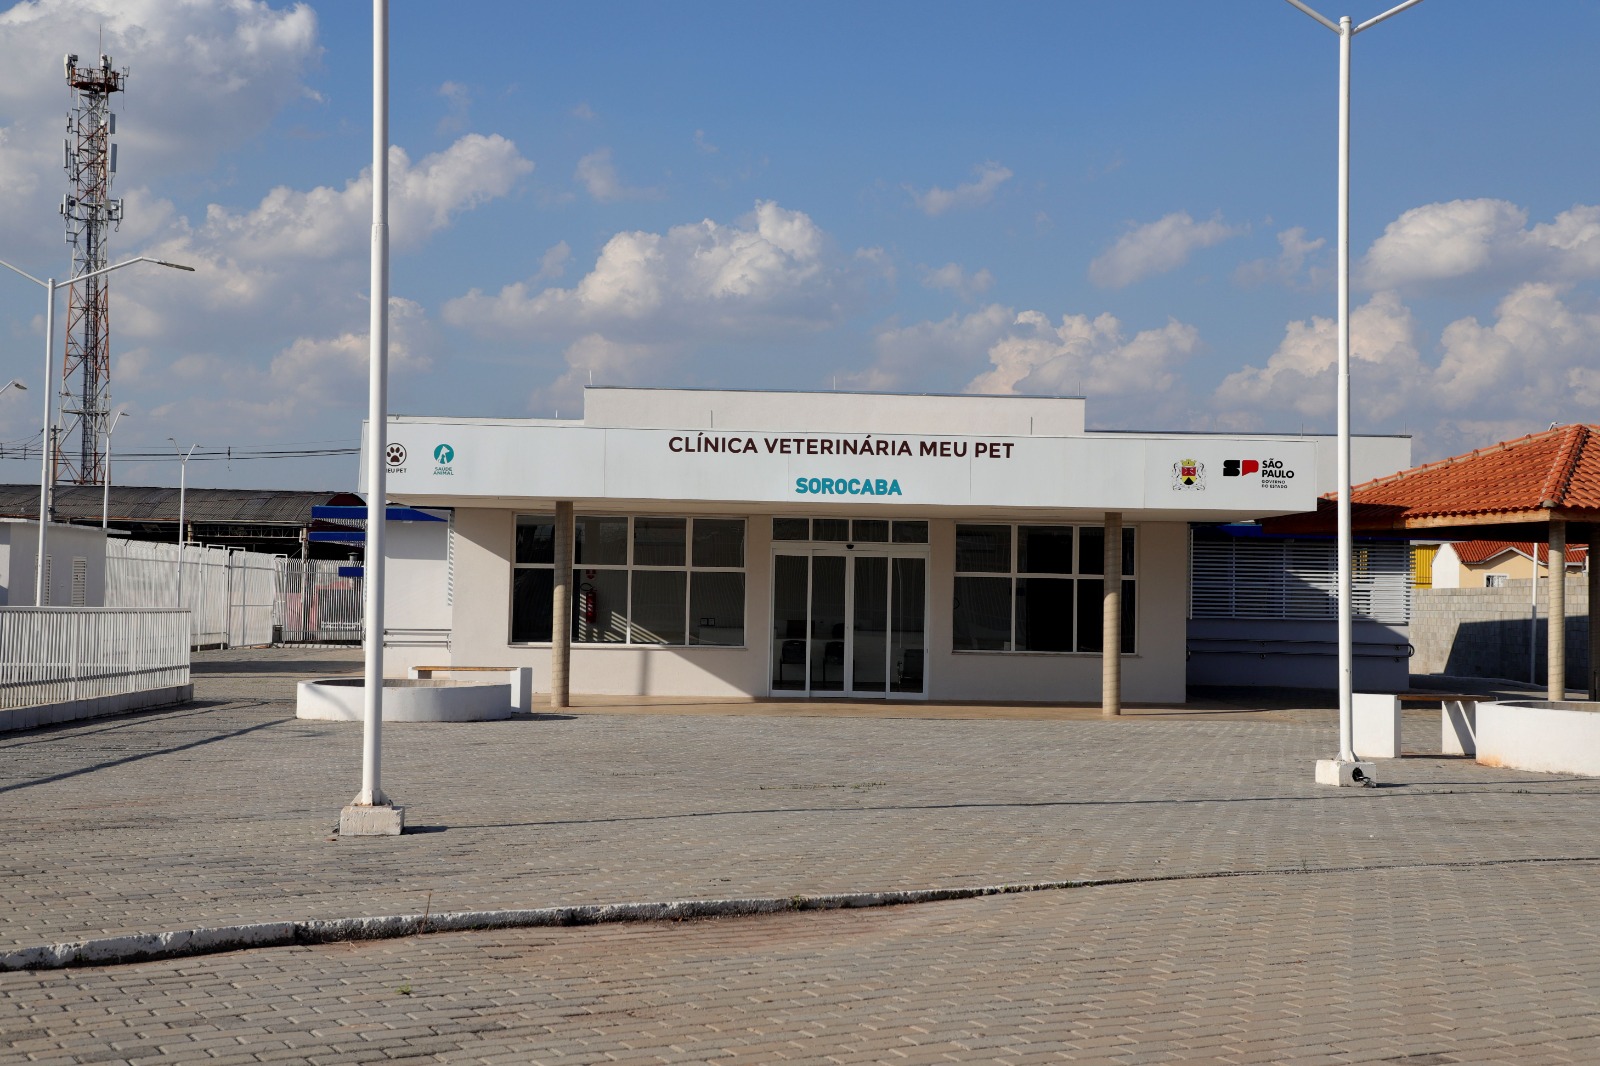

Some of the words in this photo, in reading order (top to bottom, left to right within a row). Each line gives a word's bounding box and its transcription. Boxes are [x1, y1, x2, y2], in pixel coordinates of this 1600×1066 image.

[669, 432, 758, 453] CLÍNICA
[764, 434, 912, 456] VETERINÁRIA
[919, 441, 967, 457] MEU
[974, 443, 1014, 458] PET
[1262, 458, 1283, 469] SÃO
[1262, 469, 1294, 478] PAULO
[795, 477, 902, 495] SOROCABA
